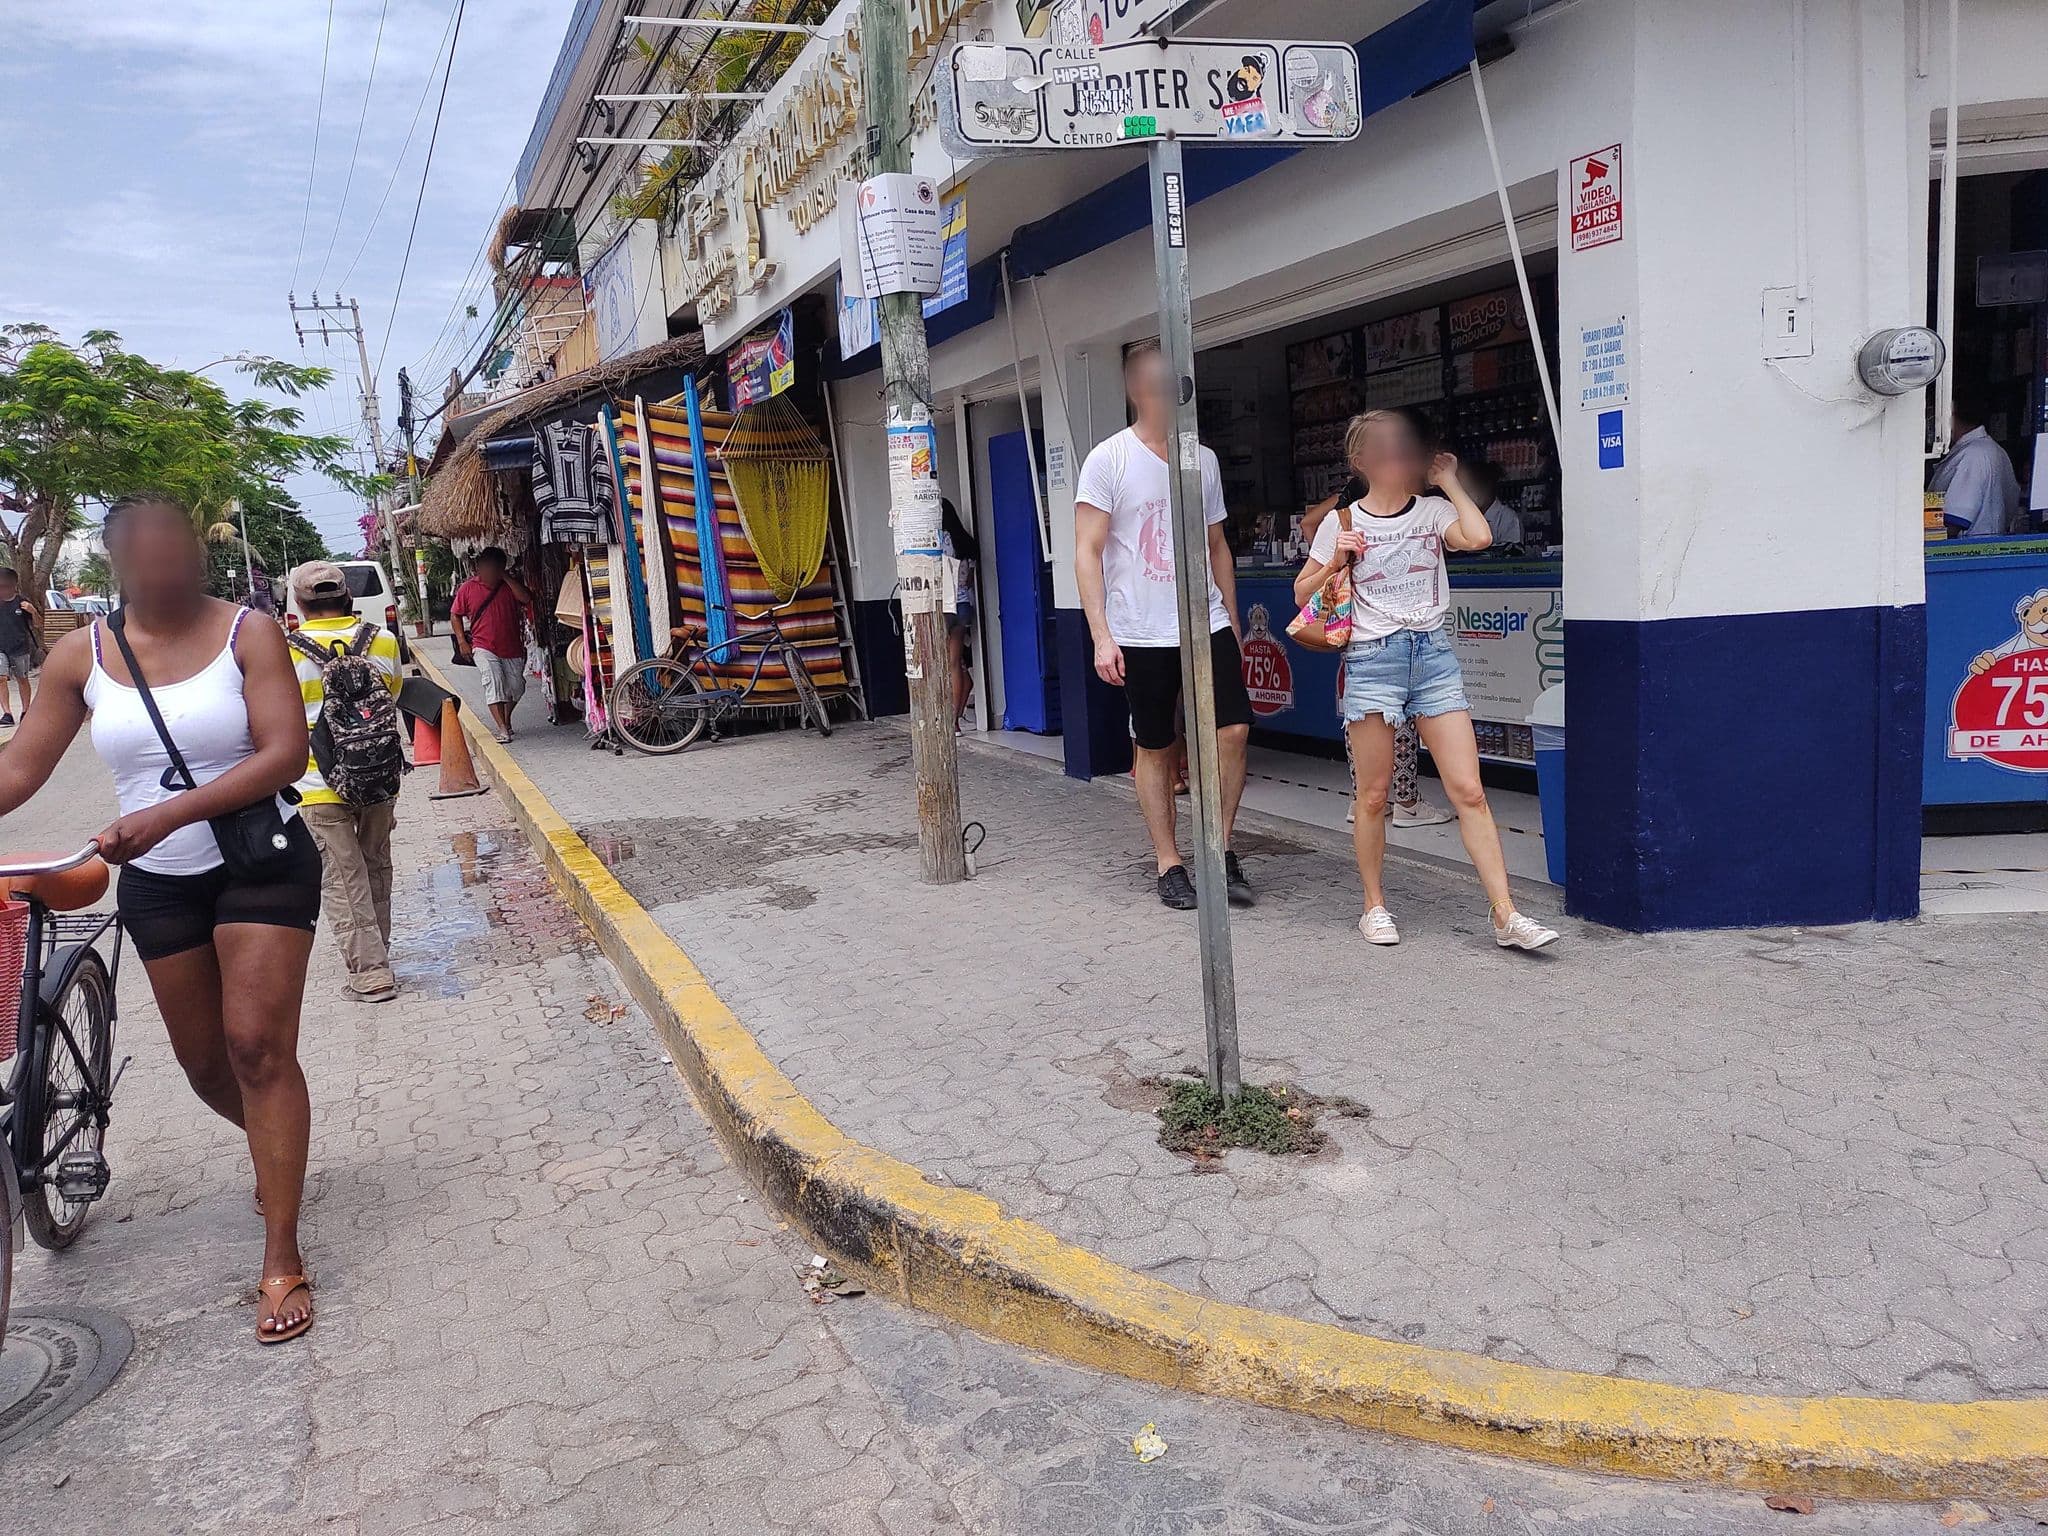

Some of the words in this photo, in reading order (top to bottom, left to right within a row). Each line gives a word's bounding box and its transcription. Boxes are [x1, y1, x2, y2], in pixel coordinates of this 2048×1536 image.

[1056, 48, 1096, 60] CALLE
[1054, 64, 1101, 84] HIPER
[1063, 132, 1113, 145] CENTRO
[1580, 185, 1612, 203] VIDEO
[1577, 194, 1616, 213] VIGILANCIA
[1576, 213, 1591, 230] 24
[1593, 205, 1618, 226] HRS
[1450, 298, 1508, 334] NUEVOS
[1451, 319, 1502, 349] PRODUCTOS
[1601, 324, 1624, 340] FARMACIA
[1585, 343, 1599, 357] LUNES
[1604, 338, 1622, 353] SABADO
[1582, 361, 1588, 372] DE
[1593, 370, 1615, 385] DOMINGO
[1582, 389, 1589, 400] DE
[1601, 436, 1622, 449] VISA
[1366, 577, 1427, 596] Budweiser
[1457, 606, 1529, 639] Nesajar
[1249, 645, 1271, 654] HASTA
[1245, 656, 1281, 688] 75%
[1255, 691, 1287, 702] AHORRO
[1970, 735, 2000, 748] DE
